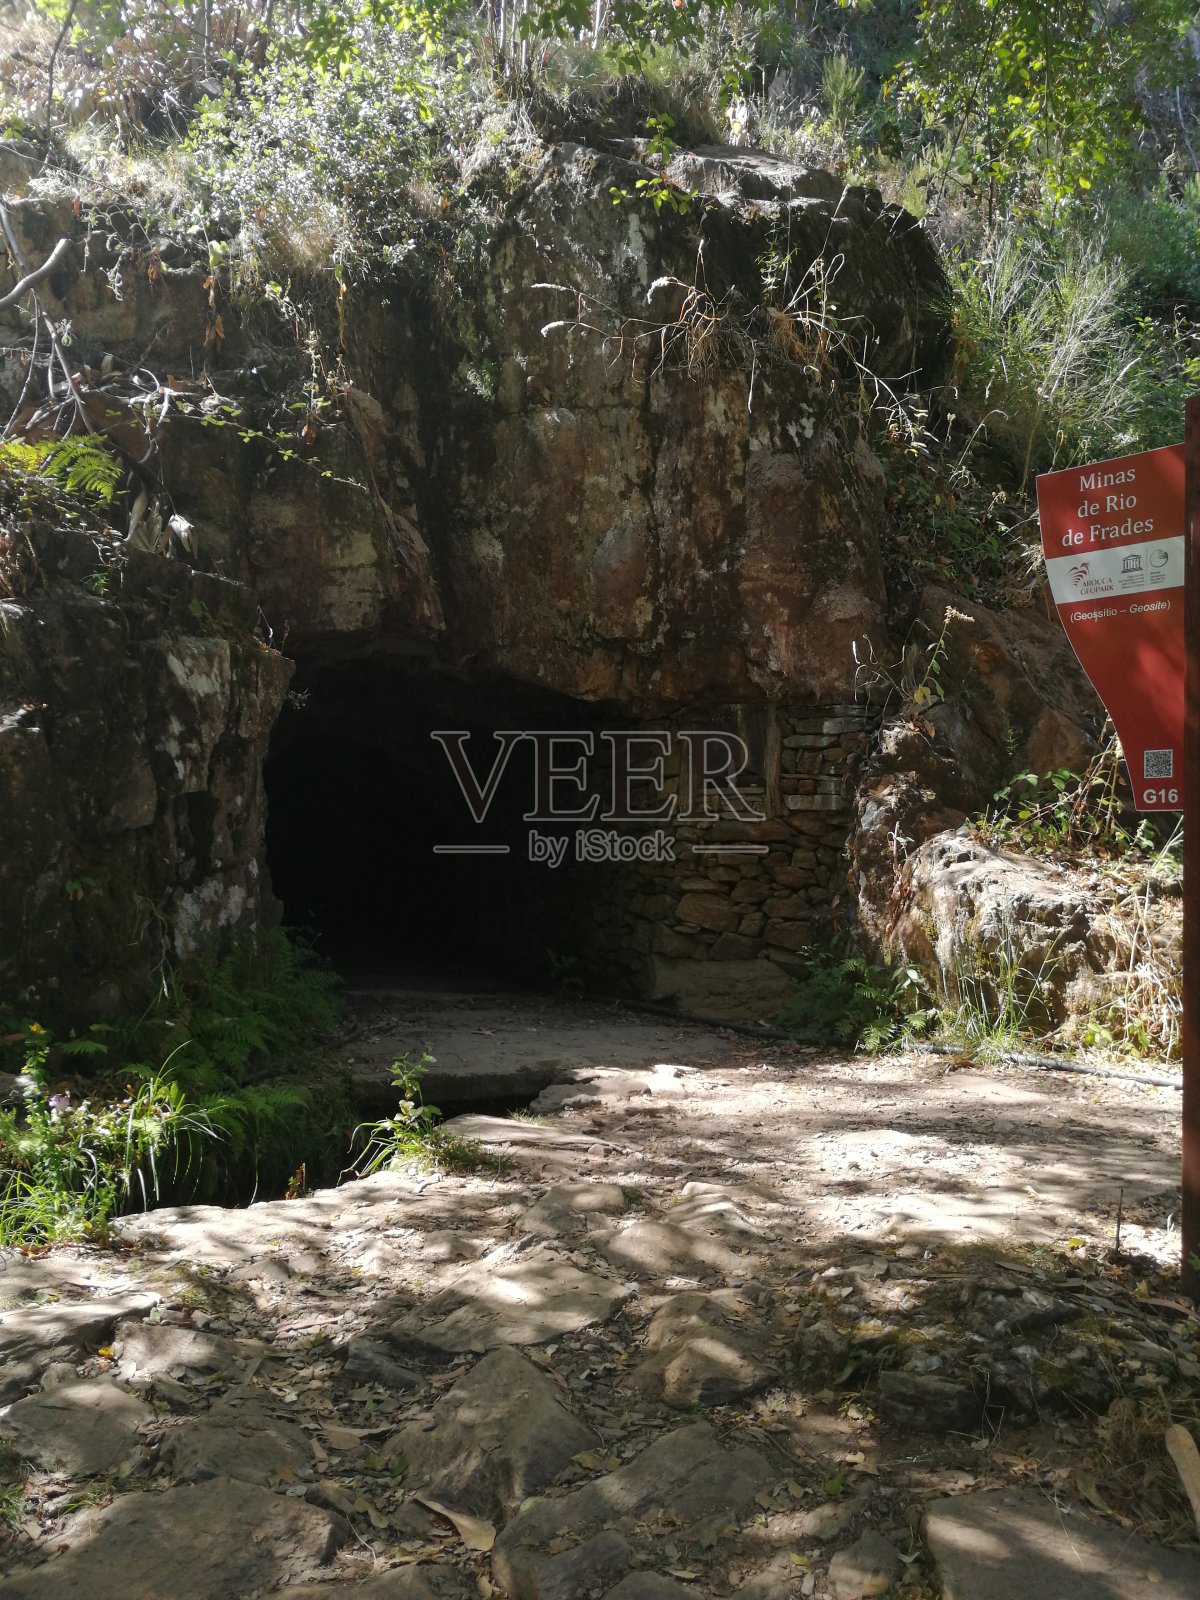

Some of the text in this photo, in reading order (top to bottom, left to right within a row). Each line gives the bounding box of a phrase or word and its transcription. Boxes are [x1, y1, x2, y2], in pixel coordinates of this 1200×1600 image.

[1079, 468, 1136, 491] Minas
[1077, 493, 1137, 518] de Rio
[1061, 518, 1154, 547] de Frades
[1082, 576, 1113, 588] AROUCA
[1080, 585, 1114, 596] GEOPARK
[1129, 599, 1171, 614] Geosite)
[1143, 788, 1178, 804] G16
